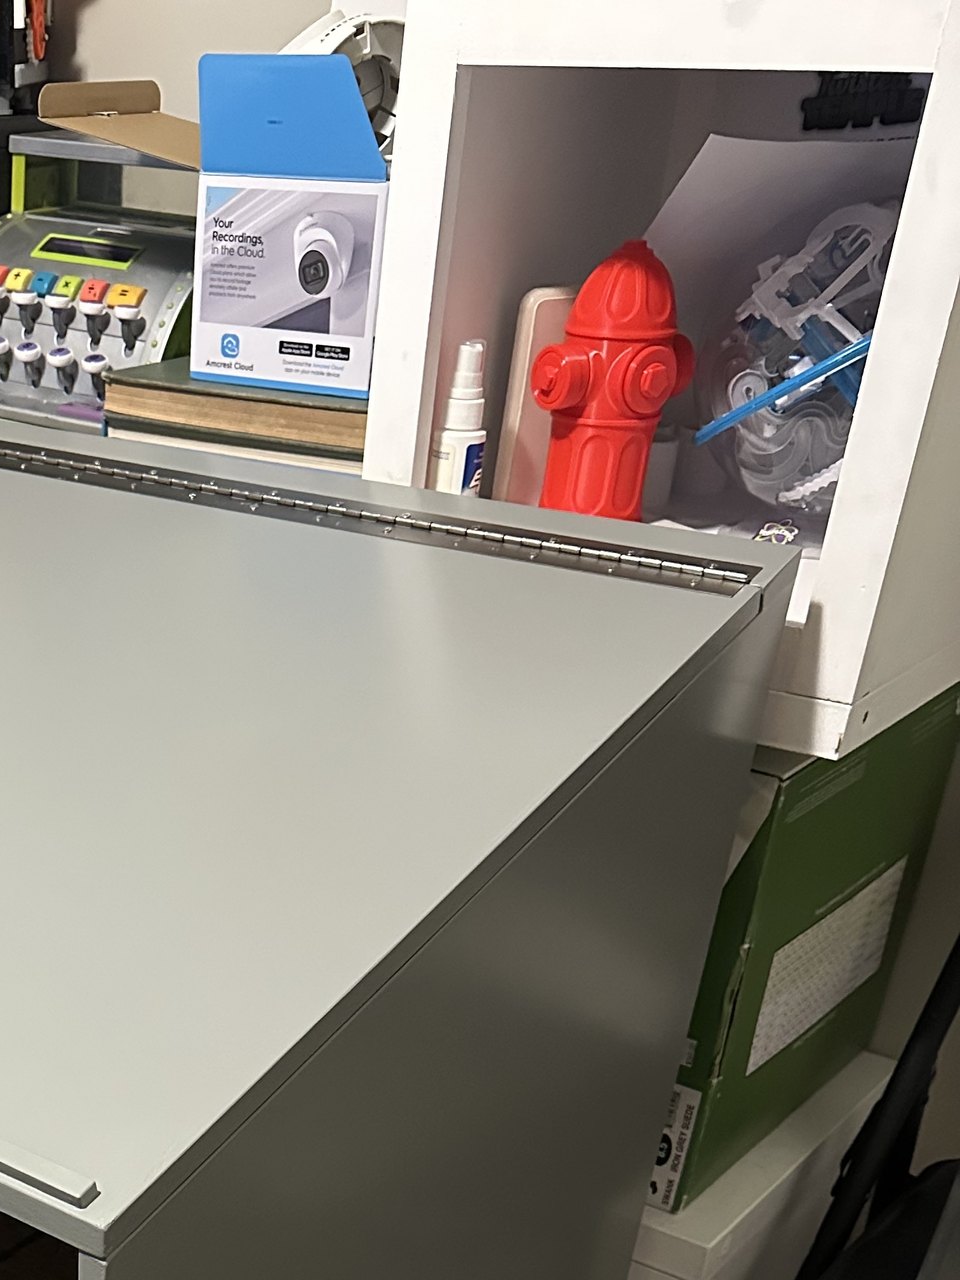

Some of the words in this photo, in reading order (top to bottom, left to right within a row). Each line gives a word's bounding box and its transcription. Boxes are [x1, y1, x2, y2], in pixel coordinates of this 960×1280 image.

[212, 216, 234, 229] Your
[212, 230, 264, 247] Recordings,
[221, 245, 235, 256] the
[206, 360, 233, 369] Amcrest
[234, 362, 254, 372] Cloud
[681, 1103, 696, 1130] SUEDE
[675, 1130, 688, 1154] GREY
